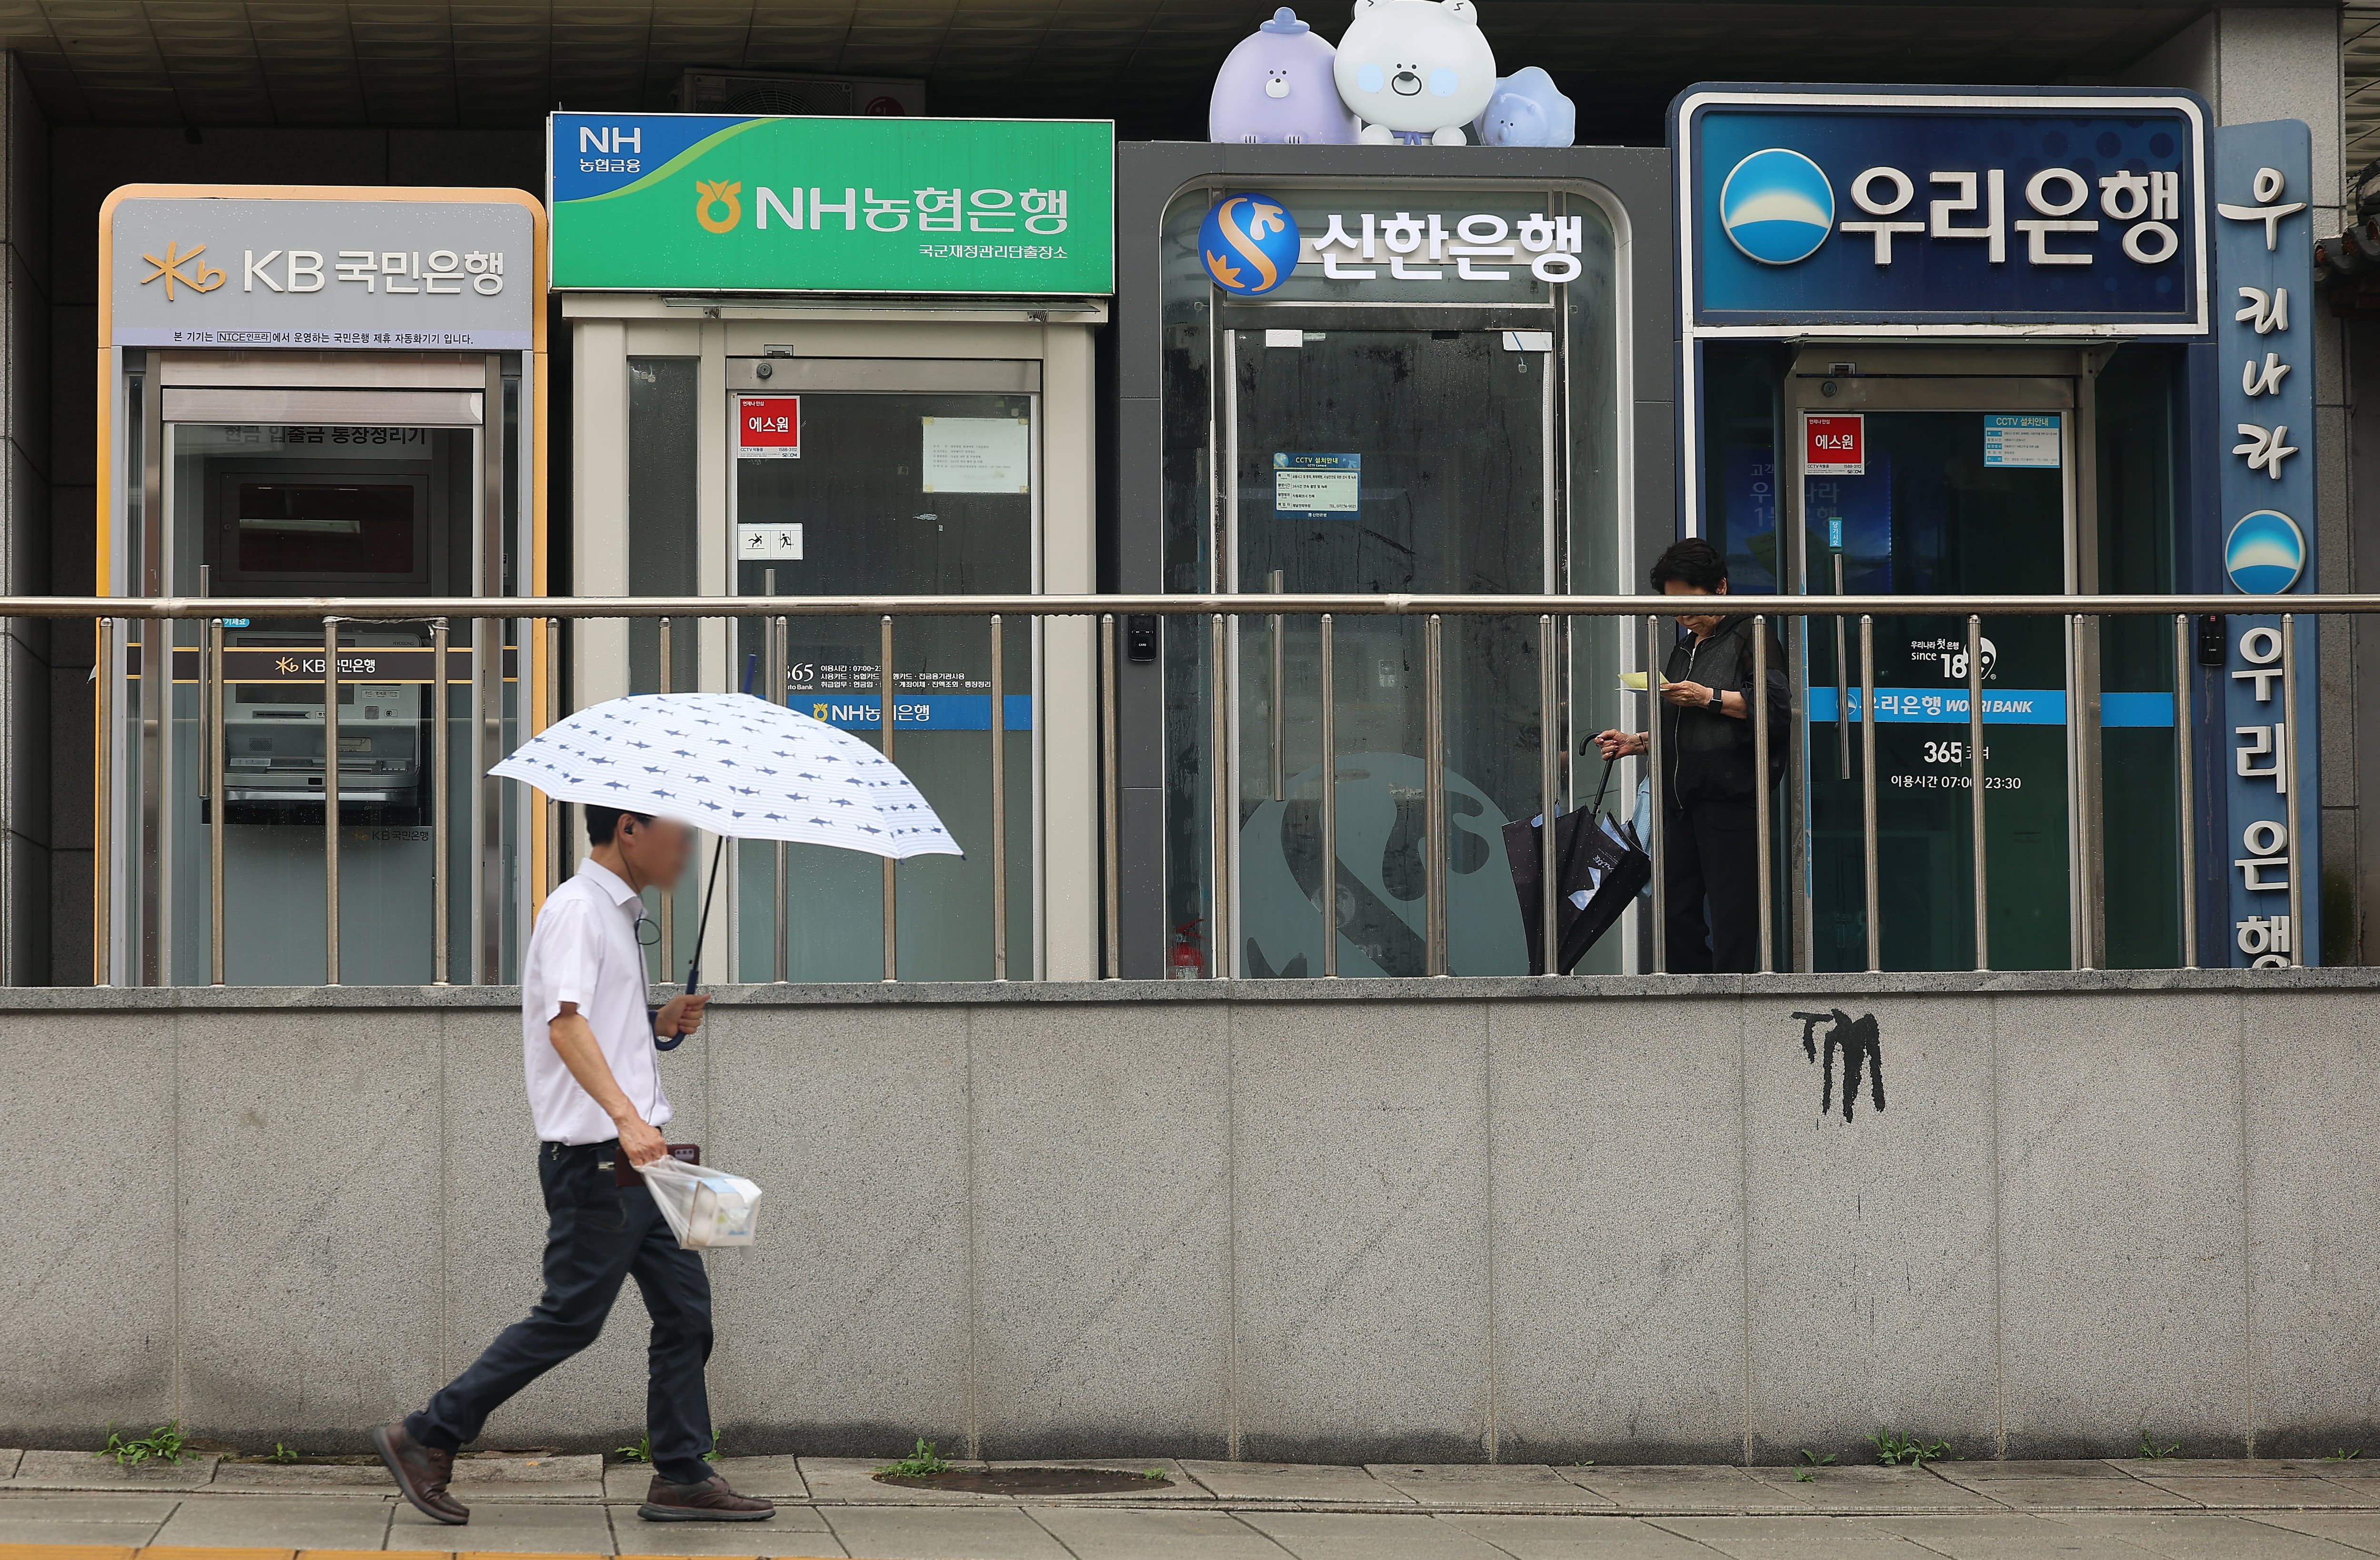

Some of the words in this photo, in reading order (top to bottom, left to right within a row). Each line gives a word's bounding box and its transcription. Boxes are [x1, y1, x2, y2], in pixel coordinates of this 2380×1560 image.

[580, 127, 641, 153] NH
[579, 158, 641, 173] 농협금융
[756, 186, 1069, 236] NH농협은행
[1839, 165, 2180, 266] 우리은행
[919, 244, 1068, 259] 국군재정관리단출장소
[1312, 211, 1583, 283] 신한은행
[244, 250, 325, 293] KB
[335, 250, 504, 296] 국민은행
[2217, 167, 2307, 480] 우리나라
[174, 331, 183, 342] 본
[187, 331, 213, 342] 기기는
[219, 333, 268, 341] NICE인프라
[272, 332, 290, 343] 에서
[294, 332, 329, 343] 운영하는
[334, 333, 369, 343] 국민은행
[374, 333, 391, 343] 제휴
[395, 334, 439, 344] 자동화기기
[444, 334, 473, 345] 입니다.
[749, 417, 789, 432] 에스원
[1996, 417, 2018, 425] CCTV
[2021, 417, 2049, 426] 설치안내
[1815, 434, 1854, 449] 에스원
[1911, 641, 1935, 649] 우리나라
[1937, 638, 1945, 650] 첫
[1946, 642, 1959, 650] 은행
[303, 659, 326, 673] KB
[832, 704, 930, 721] NH농은행
[1860, 696, 1941, 715] 리은행
[1946, 700, 1993, 712] WORI
[1993, 701, 2033, 713] BANK
[1924, 741, 1962, 763] 365
[1891, 775, 1938, 788] 이용시간
